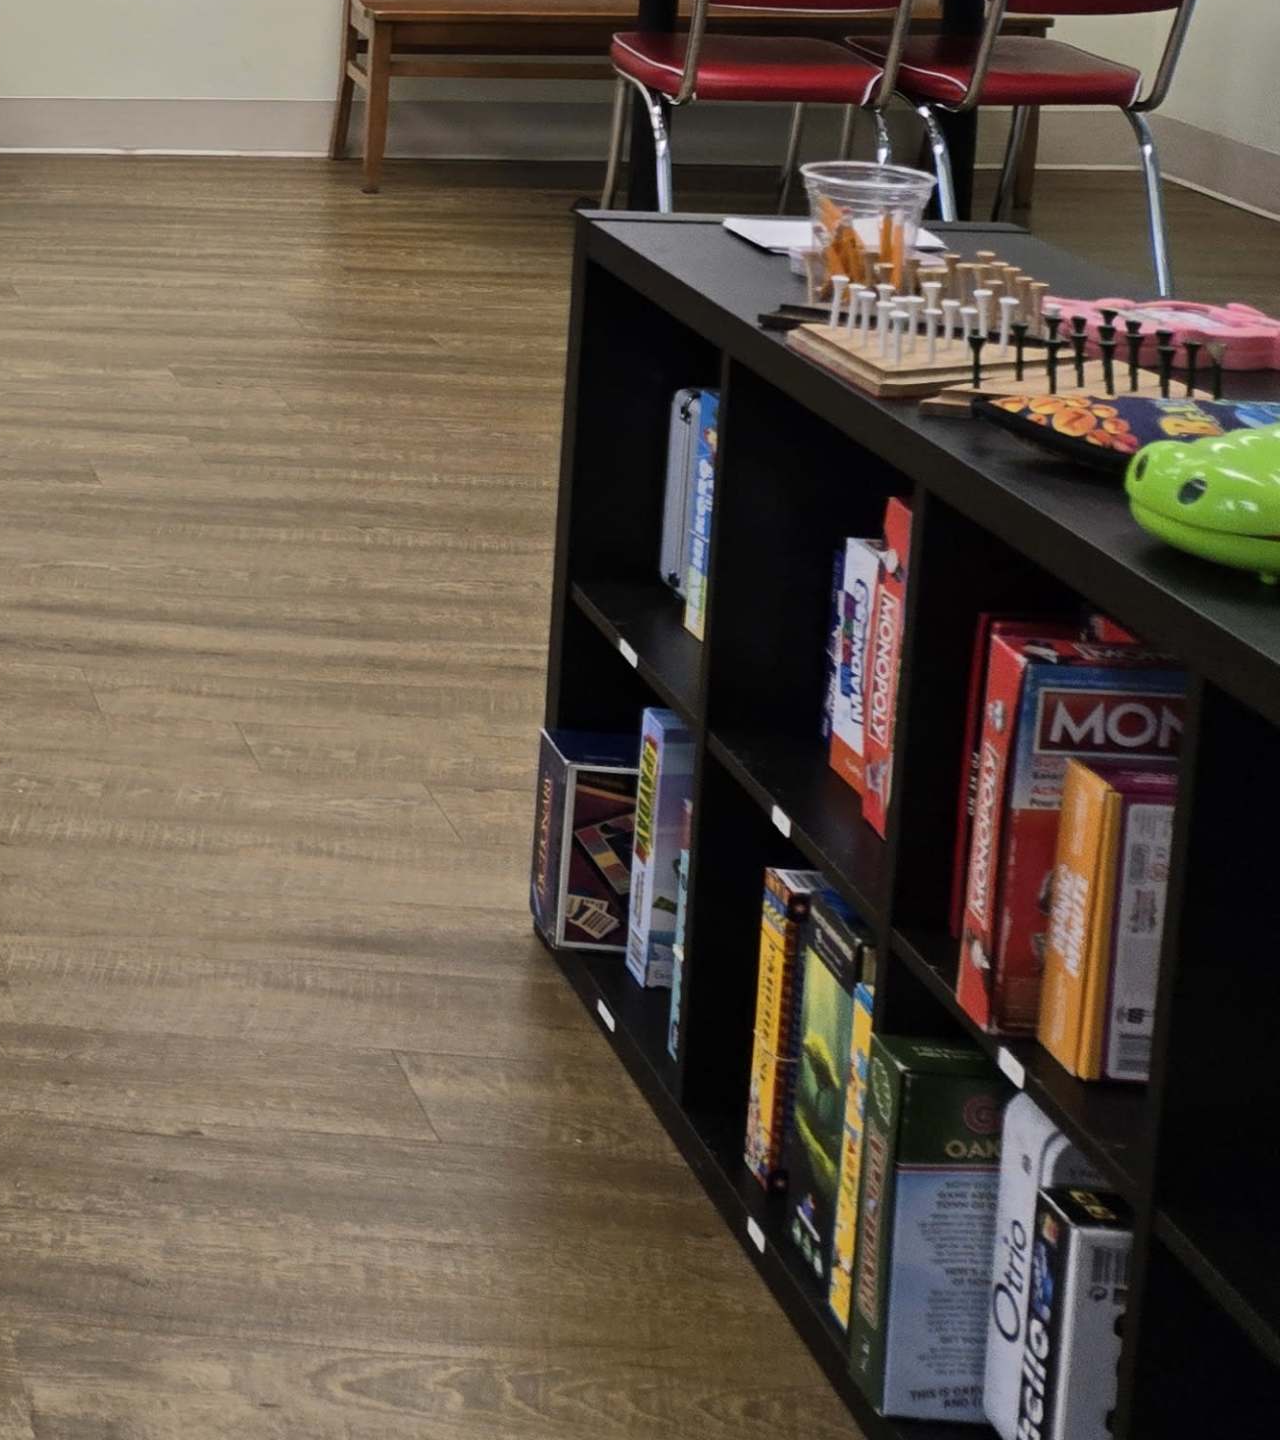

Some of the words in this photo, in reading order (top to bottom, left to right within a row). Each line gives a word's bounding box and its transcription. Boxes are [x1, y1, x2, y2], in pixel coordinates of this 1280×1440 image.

[871, 594, 897, 742] MONOPOLY
[971, 750, 997, 917] MONOPOLY
[993, 1220, 1028, 1343] Otrio
